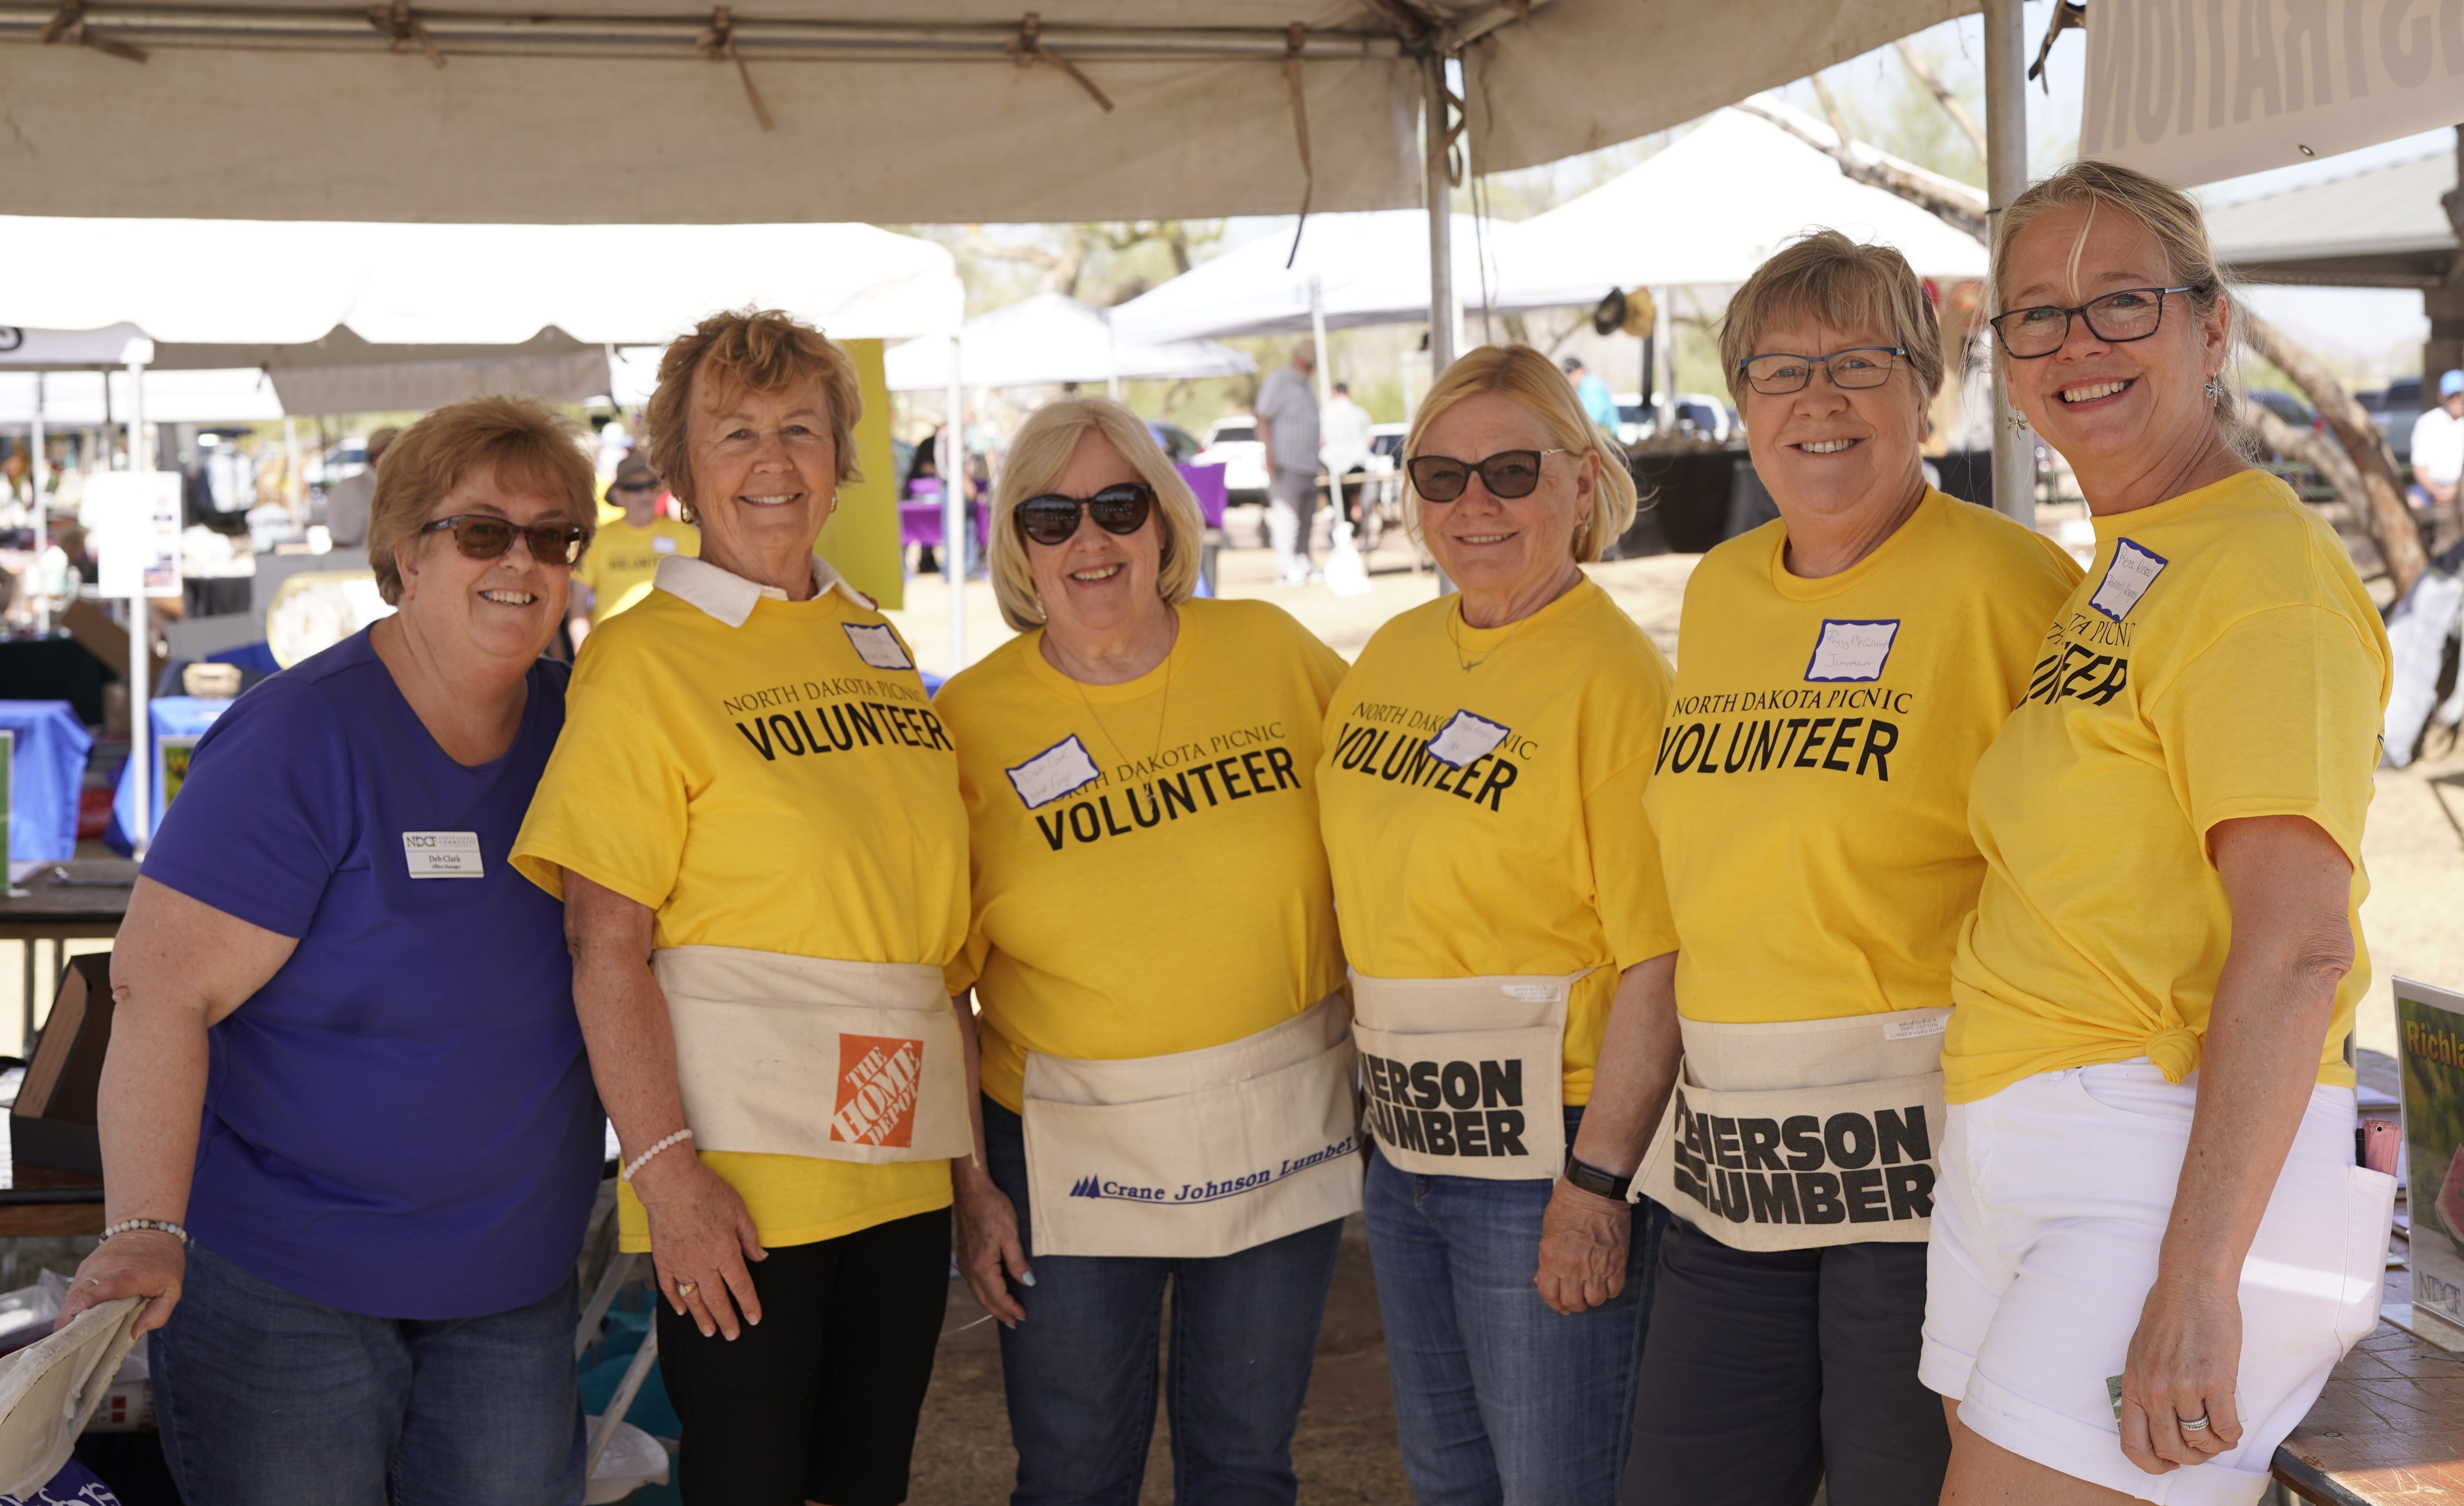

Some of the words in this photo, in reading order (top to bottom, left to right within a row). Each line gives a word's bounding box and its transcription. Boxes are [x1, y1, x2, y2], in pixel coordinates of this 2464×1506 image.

[723, 684, 802, 715] NORTH
[803, 677, 878, 701] DAKOTA
[1351, 701, 1408, 725] NORTH
[1673, 693, 1739, 717] NORTH
[1740, 689, 1821, 712] DAKOTA
[1827, 687, 1913, 714] PICNIC
[735, 701, 954, 761] VOLUNTEER
[1117, 743, 1207, 783] DAKOTA
[1210, 721, 1286, 753] PICNIC
[1654, 717, 1899, 782] VOLUNTEER
[1036, 747, 1302, 851] VOLUNTEER
[406, 836, 438, 847] NDCF
[832, 1041, 922, 1144] HOME
[844, 1046, 888, 1090] THE
[867, 1078, 918, 1146] DEPOT
[1103, 1181, 1165, 1200] Crane
[1174, 1169, 1271, 1201] Johnson
[1279, 1136, 1353, 1177] Lumber
